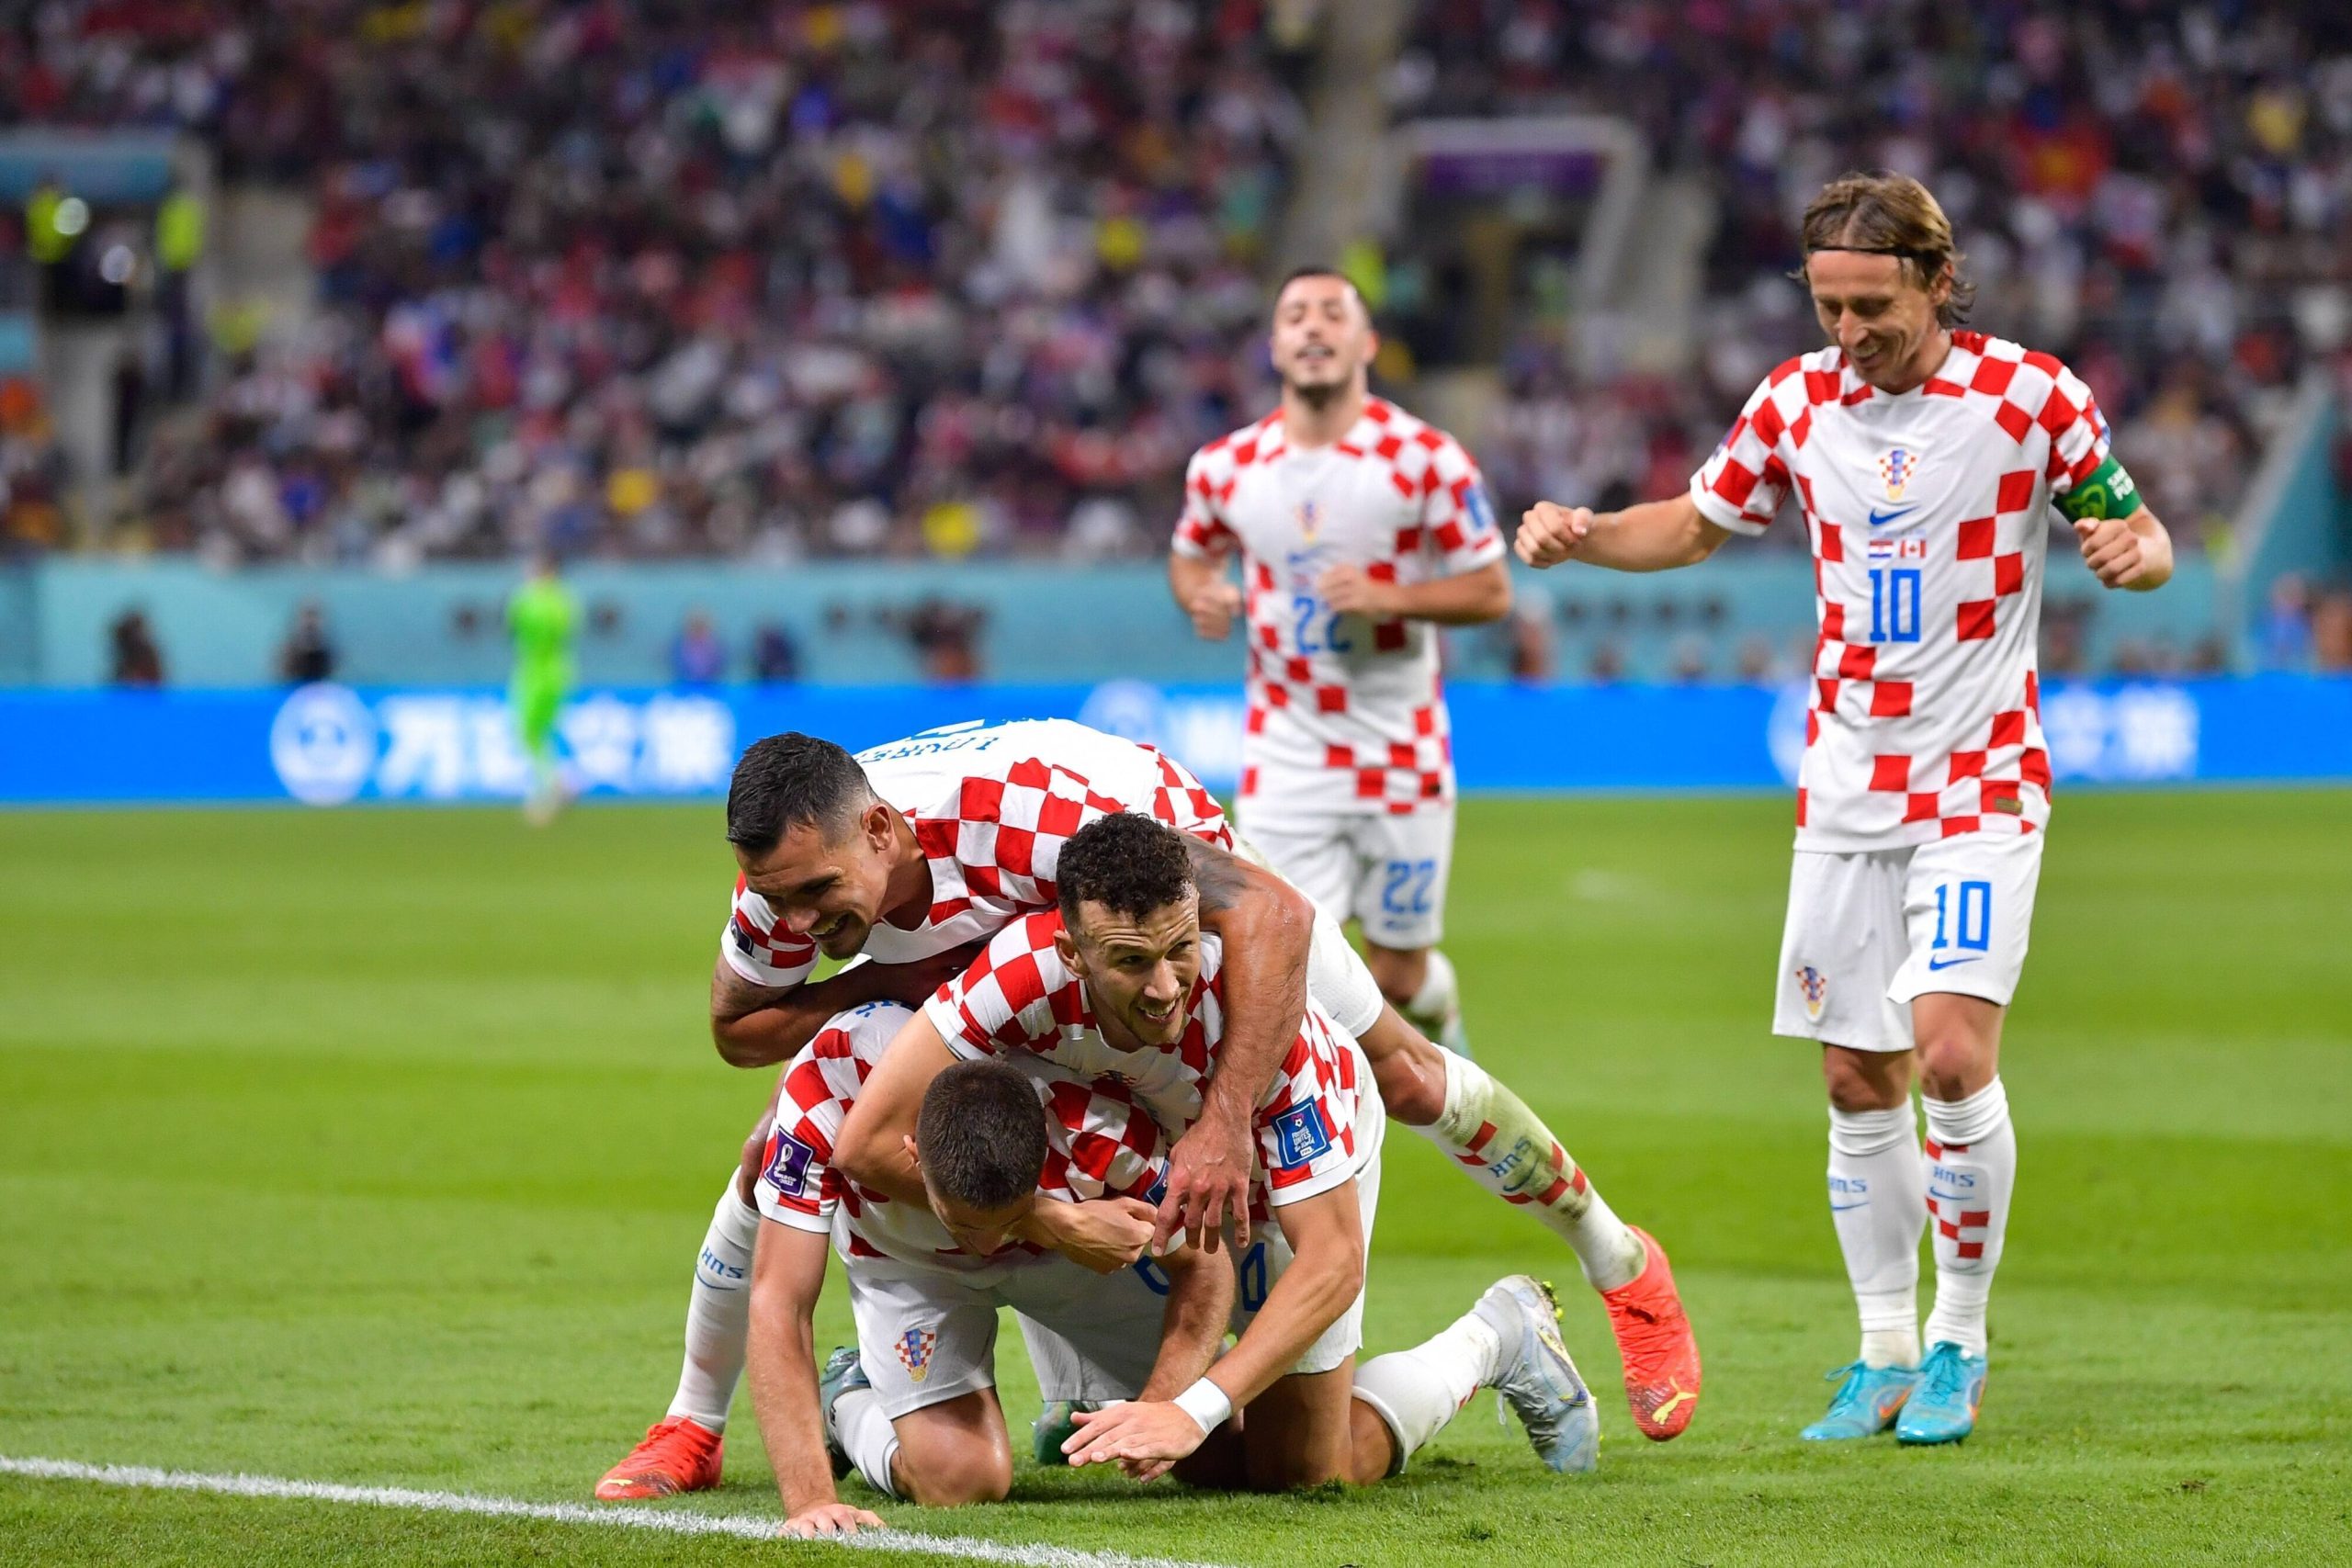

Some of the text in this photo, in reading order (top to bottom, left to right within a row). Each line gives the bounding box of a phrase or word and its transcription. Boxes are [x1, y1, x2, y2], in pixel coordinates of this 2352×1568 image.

[1868, 569, 1920, 643] 10
[1383, 860, 1435, 914] 22
[1932, 880, 1991, 952] 10
